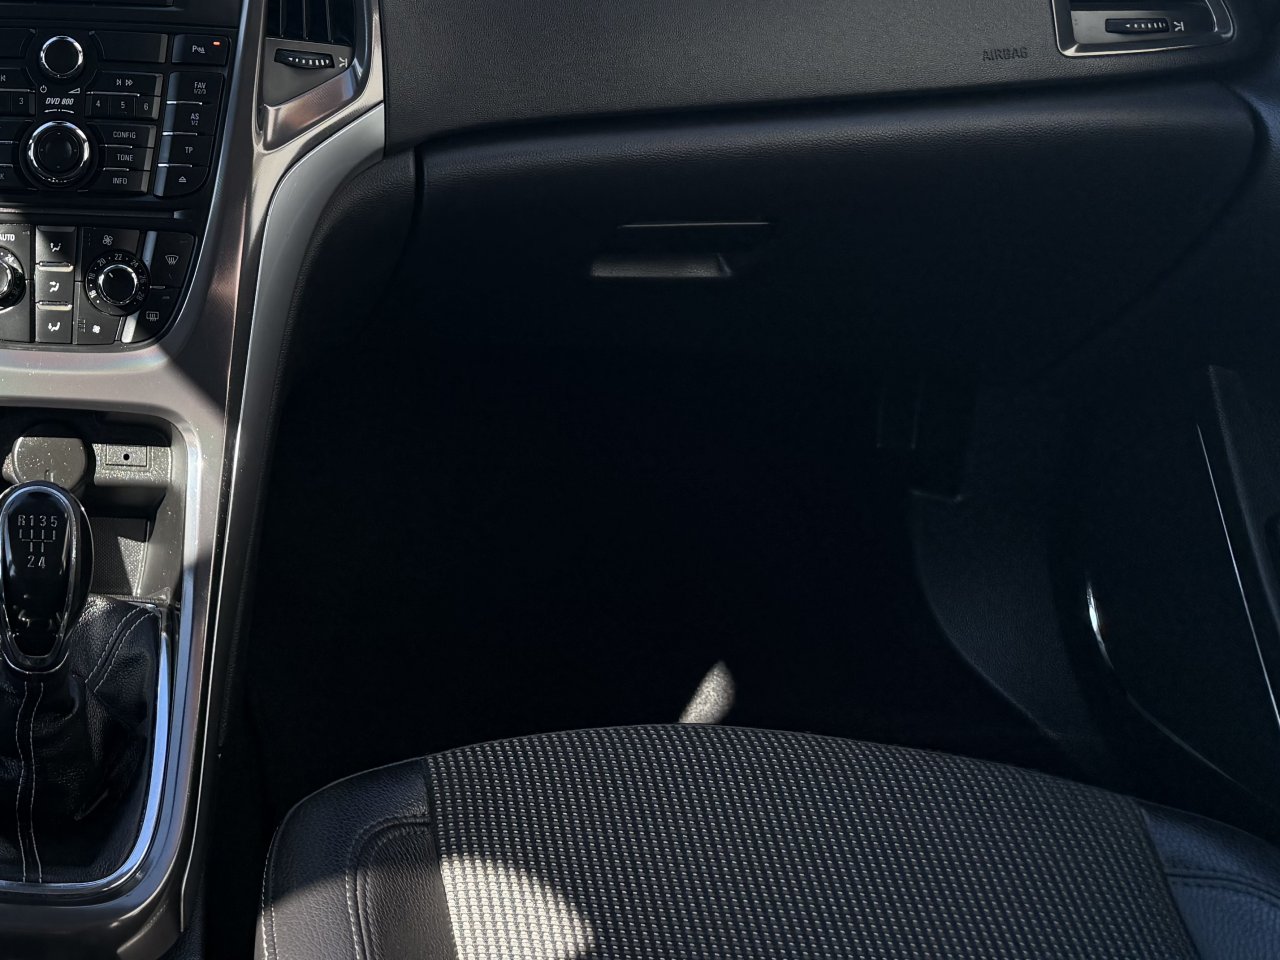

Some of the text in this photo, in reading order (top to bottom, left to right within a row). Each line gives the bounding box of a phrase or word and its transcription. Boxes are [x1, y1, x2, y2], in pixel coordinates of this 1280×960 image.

[982, 47, 1028, 61] AIRBAG
[194, 81, 206, 89] FAV
[19, 97, 24, 105] 3
[45, 97, 60, 105] DVD
[143, 103, 148, 111] 6
[113, 131, 136, 139] CONFIG
[112, 177, 127, 185] INFO
[5, 253, 14, 262] 24
[97, 257, 106, 267] 20
[130, 259, 139, 268] 24
[88, 272, 96, 280] 18
[29, 515, 34, 526] 1
[39, 515, 47, 527] 3
[50, 515, 58, 527] 5
[27, 556, 46, 569] 2 4
